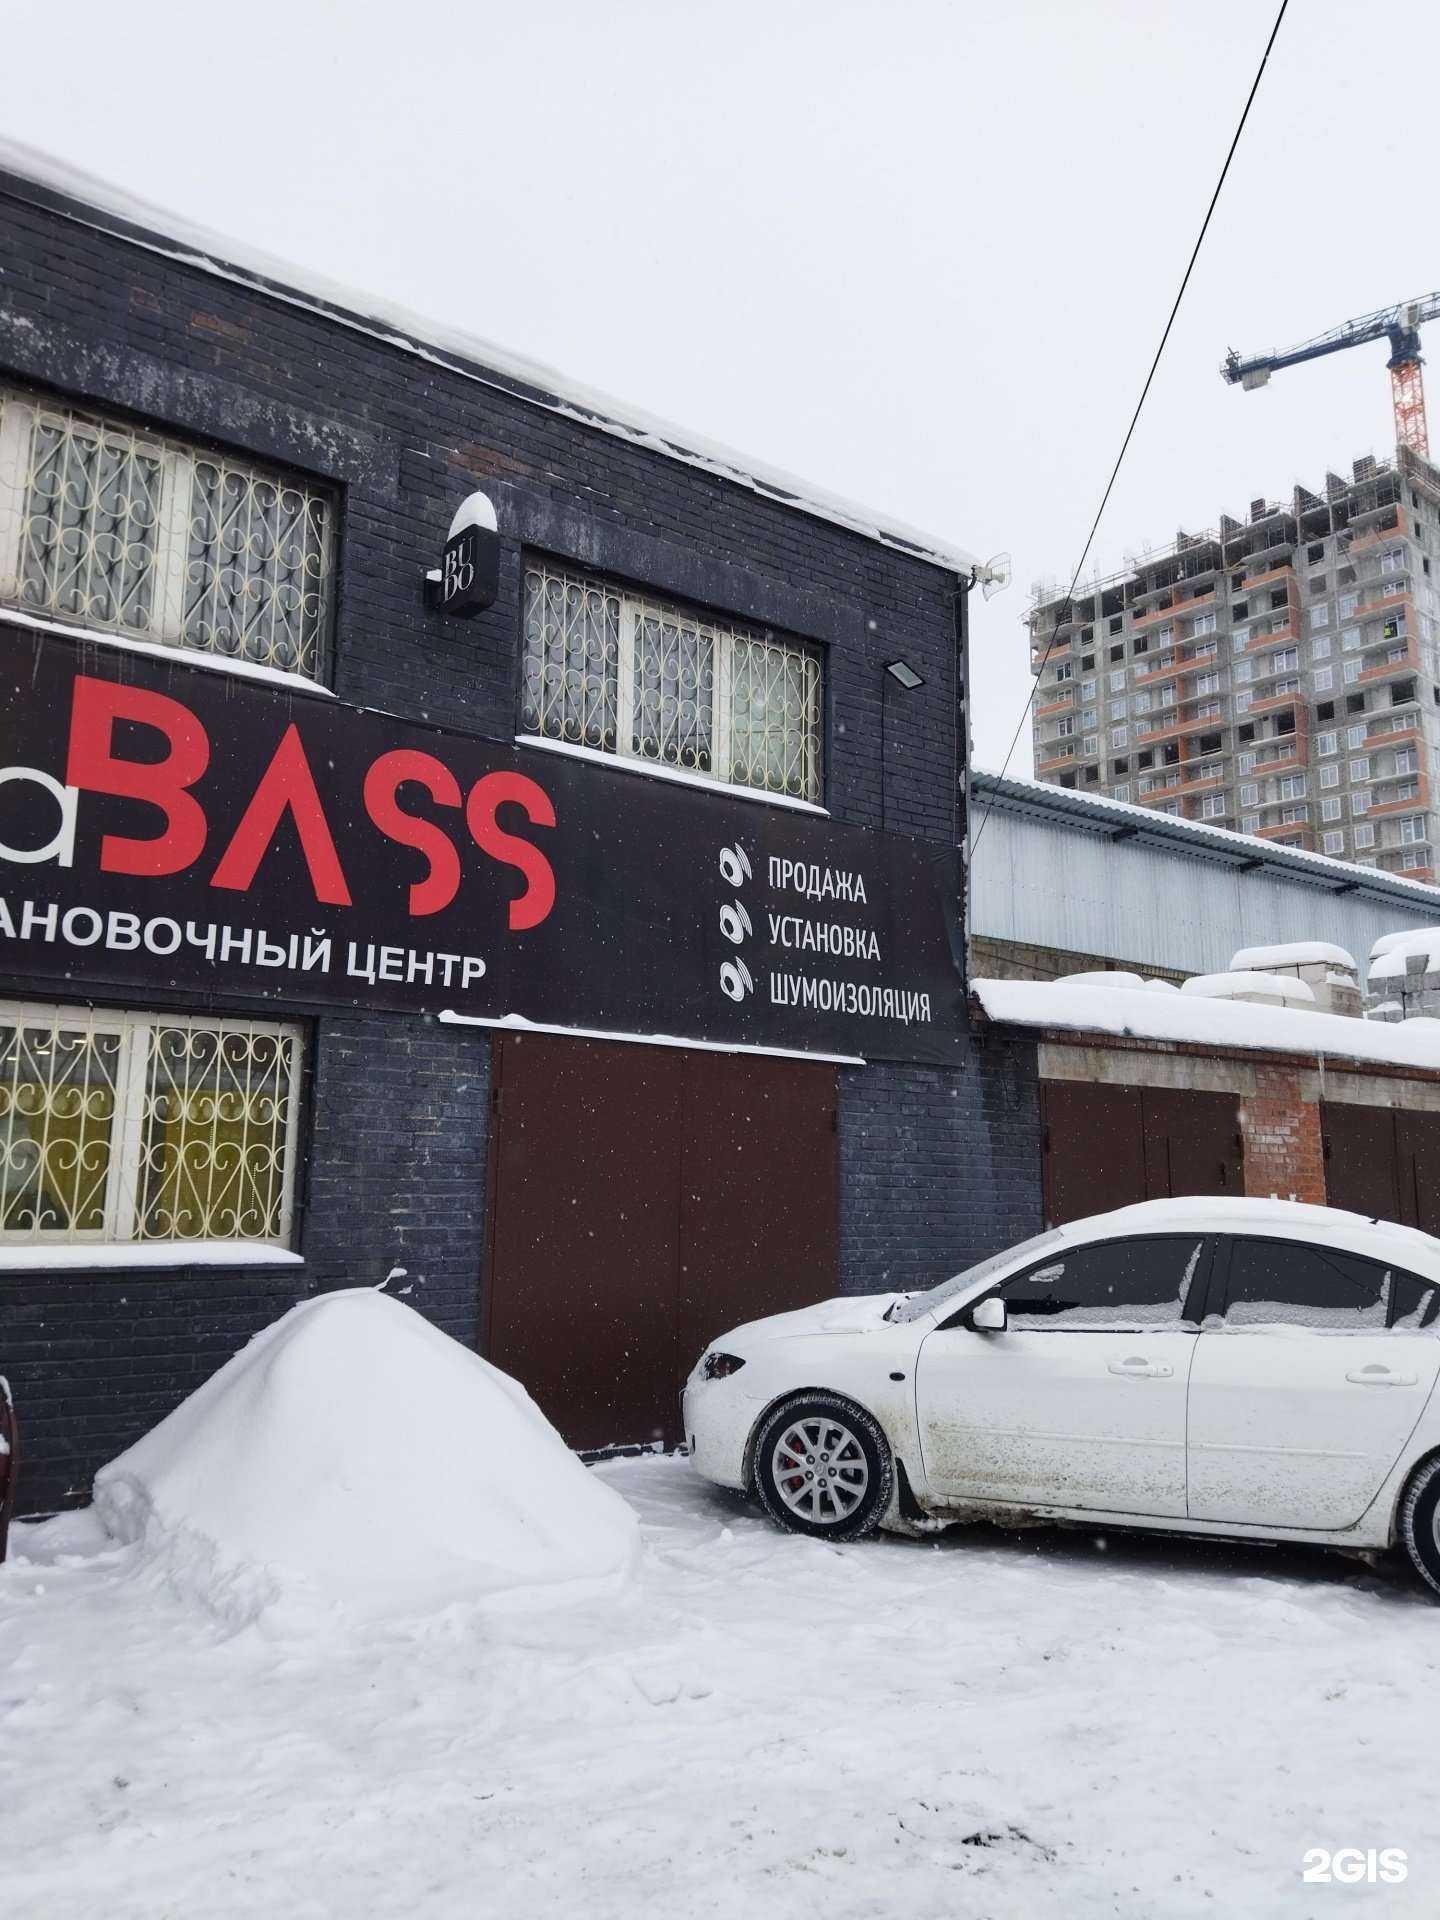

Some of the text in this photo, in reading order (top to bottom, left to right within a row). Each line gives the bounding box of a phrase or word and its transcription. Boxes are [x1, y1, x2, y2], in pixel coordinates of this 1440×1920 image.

[768, 855, 868, 904] ПРОДАЖА
[768, 912, 881, 961] УСТАНОВКА
[347, 941, 487, 989] ЦЕНТР
[769, 971, 932, 1026] ШУМОИЗОЛЯЦИЯ
